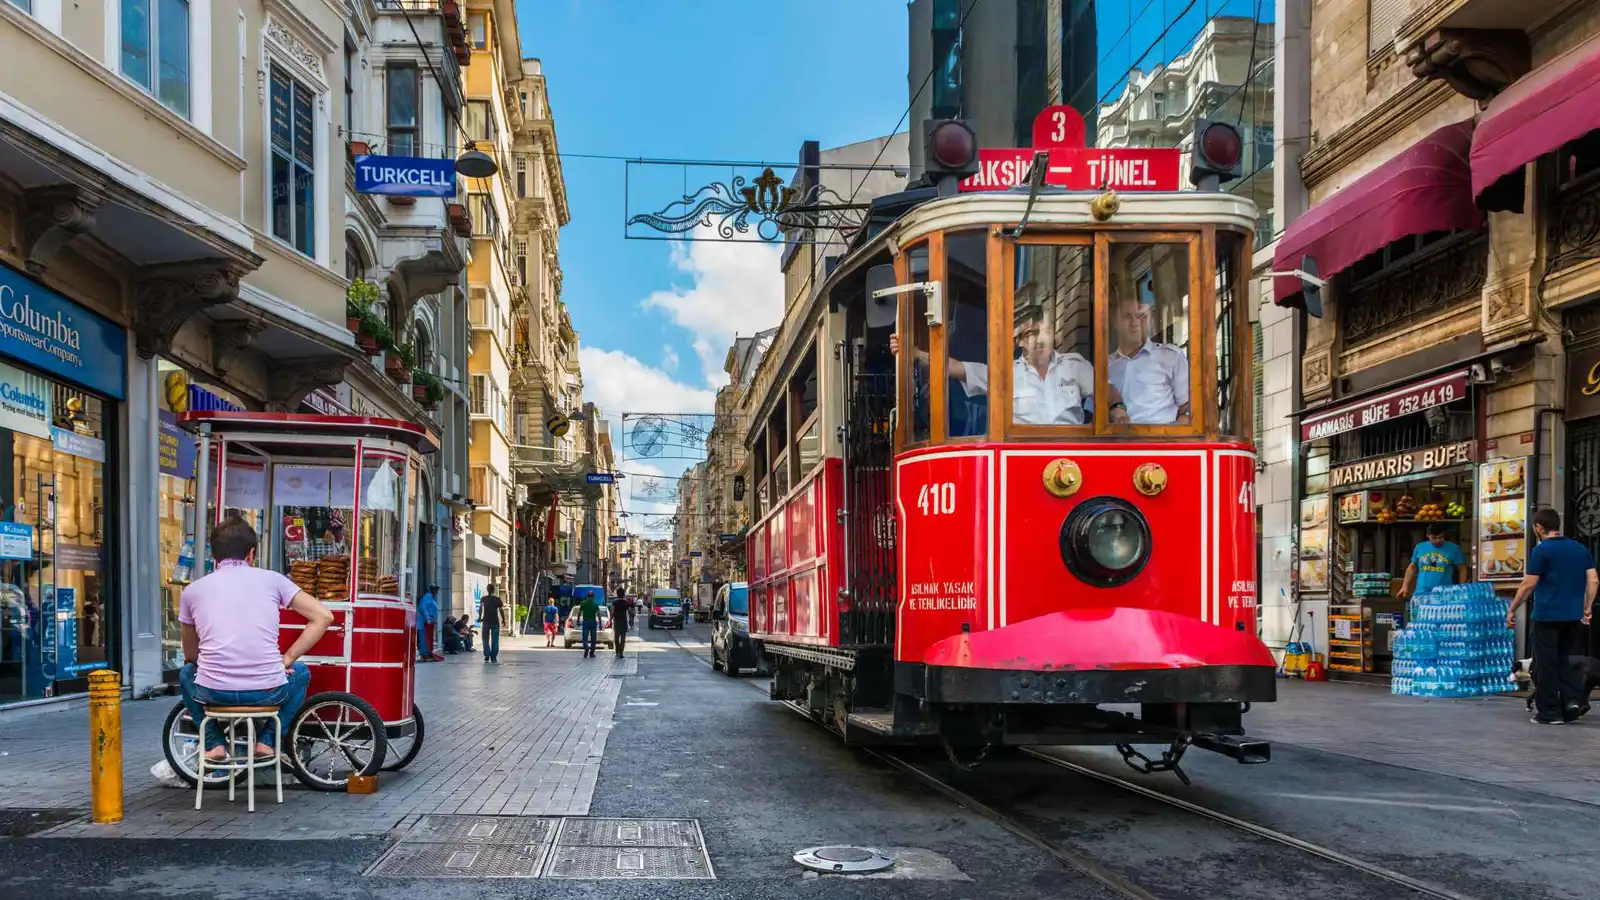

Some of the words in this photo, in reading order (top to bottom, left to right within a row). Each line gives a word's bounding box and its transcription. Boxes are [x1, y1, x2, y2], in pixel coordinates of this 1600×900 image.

[1051, 111, 1066, 143] 3
[360, 165, 451, 186] TURKCELL
[1087, 155, 1156, 186] TÜNEL
[0, 285, 80, 350] Columbia
[2, 383, 46, 411] Columbia
[1309, 412, 1354, 439] MARMARİS
[1362, 404, 1390, 425] BÜFE
[1398, 395, 1419, 414] 252
[1421, 390, 1436, 408] 44
[1438, 385, 1454, 401] 19
[1423, 443, 1468, 468] BÜFE
[918, 482, 955, 516] 410
[911, 582, 939, 595] ASILMAK
[943, 581, 974, 594] YASAK
[1227, 595, 1239, 608] VE
[918, 595, 977, 610] TEHLİKELİDİR
